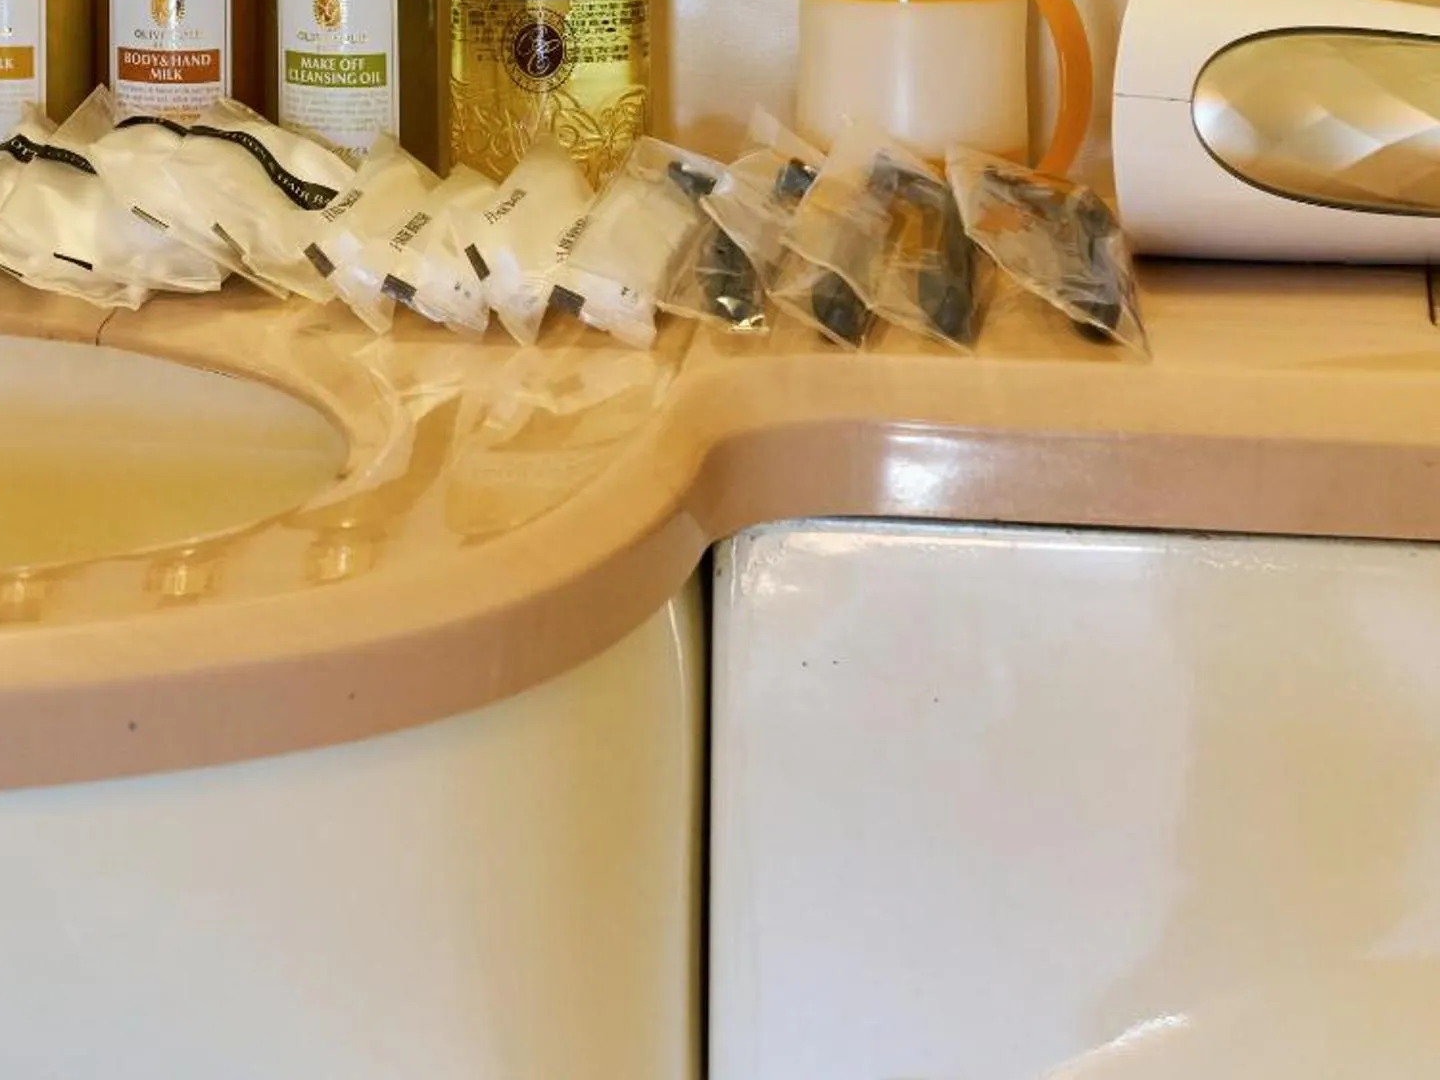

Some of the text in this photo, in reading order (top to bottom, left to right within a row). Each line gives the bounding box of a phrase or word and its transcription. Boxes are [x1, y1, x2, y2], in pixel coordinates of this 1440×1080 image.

[300, 57, 366, 71] MAKE OFF
[148, 68, 184, 81] MILK
[289, 69, 380, 85] CLEANSING OIL
